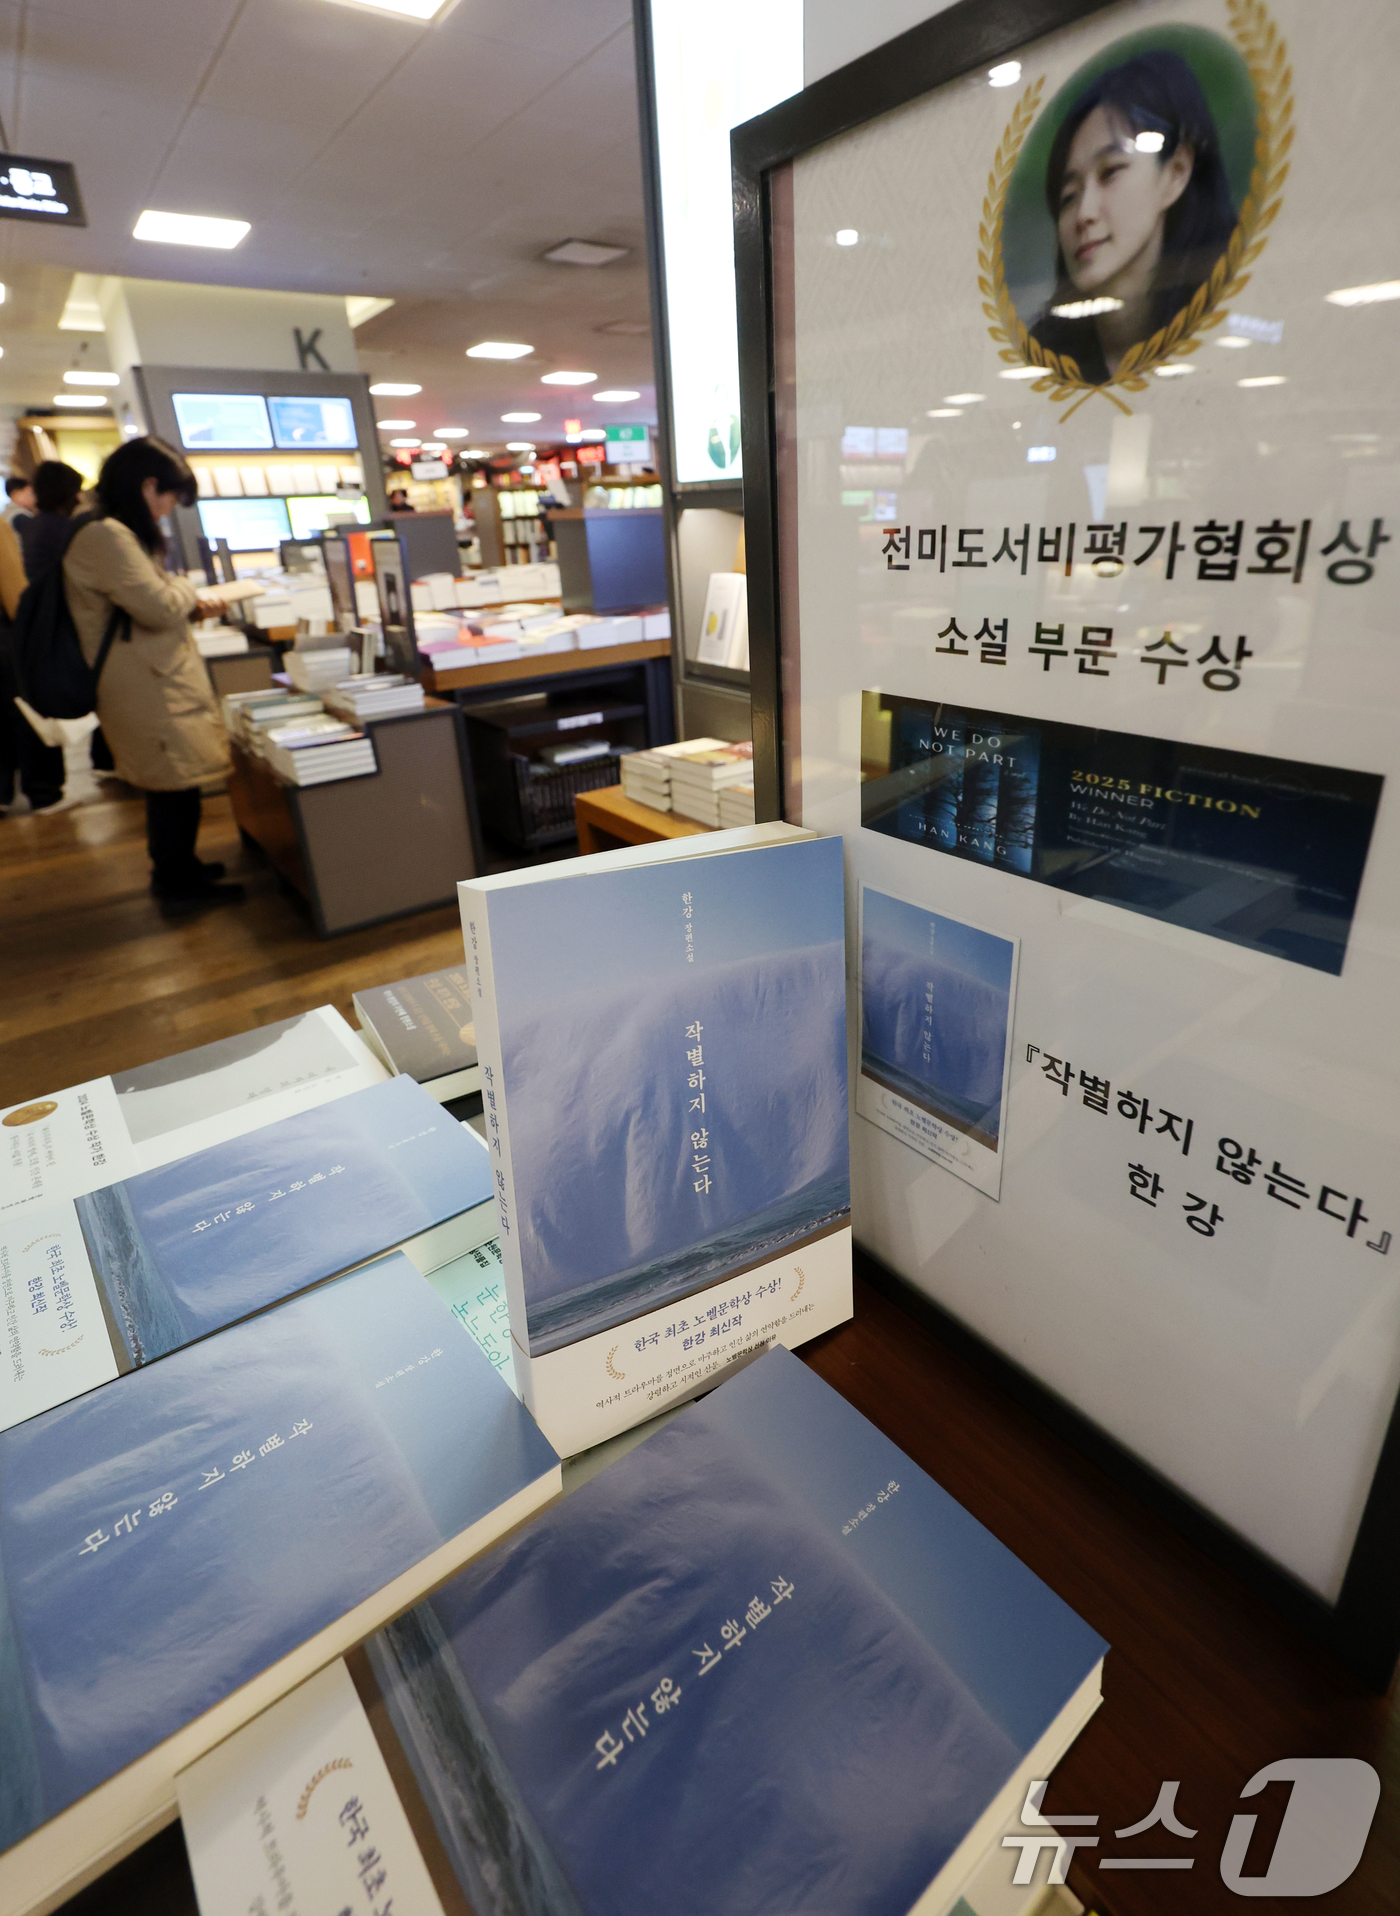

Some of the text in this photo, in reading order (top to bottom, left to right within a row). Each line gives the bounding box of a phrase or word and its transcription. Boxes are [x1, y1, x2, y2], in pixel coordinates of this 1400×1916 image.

[294, 327, 331, 371] K
[881, 517, 1392, 586] 전미도서비평가협회상
[934, 616, 1254, 692] 소설 부문 수상
[919, 739, 1017, 768] NOT PART
[933, 726, 1001, 748] WE DO
[1069, 783, 1155, 810] WINNER
[1071, 769, 1131, 791] 2025
[1138, 783, 1262, 819] FICTION
[918, 822, 949, 839] HAN
[959, 834, 1007, 856] KANG
[682, 892, 694, 963] 한강 장편소설
[685, 1021, 712, 1195] 작별하지 않는다
[484, 1066, 510, 1236] 작별하지 않는다
[192, 1164, 345, 1233] 작별하지 않는다
[1126, 1161, 1226, 1239] 한 강
[28, 1276, 48, 1315] 한강 최신작
[46, 1244, 78, 1333] 한국 최초 노벨문학상 수상!
[633, 1278, 782, 1353] 한국 최초 노벨문학상 수상!
[418, 1348, 443, 1365] 한강
[595, 1392, 622, 1410] 역사적
[665, 1359, 697, 1381] 정면으로
[697, 1343, 728, 1364] 마주하고
[728, 1336, 743, 1350] 인간
[744, 1328, 759, 1343] 삶의
[788, 1302, 815, 1321] 드러내는
[682, 1314, 743, 1351] 한강 최신작
[680, 1368, 703, 1386] 시적인
[78, 1418, 313, 1555] 작별하지 않는다
[841, 1480, 900, 1536] 한강 장편소설
[595, 1575, 795, 1770] 작별하지 않는다
